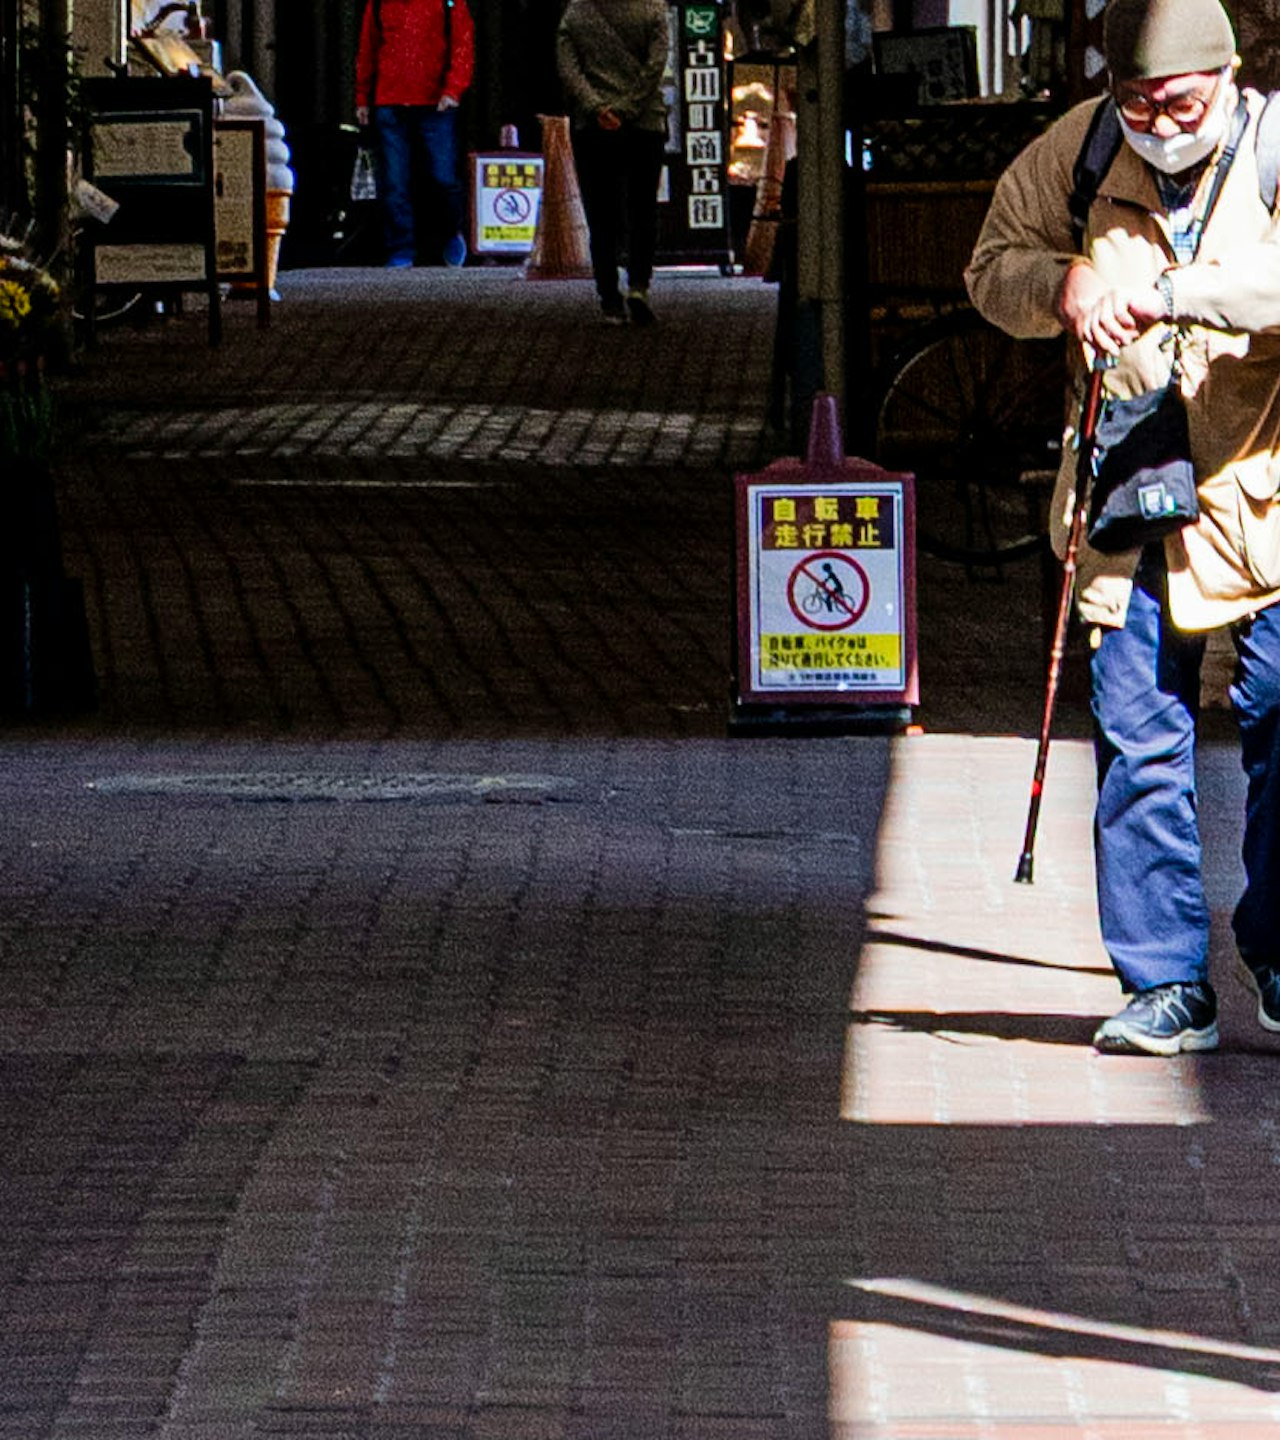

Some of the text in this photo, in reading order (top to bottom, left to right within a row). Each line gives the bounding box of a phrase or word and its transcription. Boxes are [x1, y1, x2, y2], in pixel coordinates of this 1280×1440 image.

[684, 38, 725, 230] 古川町商店街
[773, 497, 879, 521] 自転車
[775, 524, 881, 548] 走行禁止
